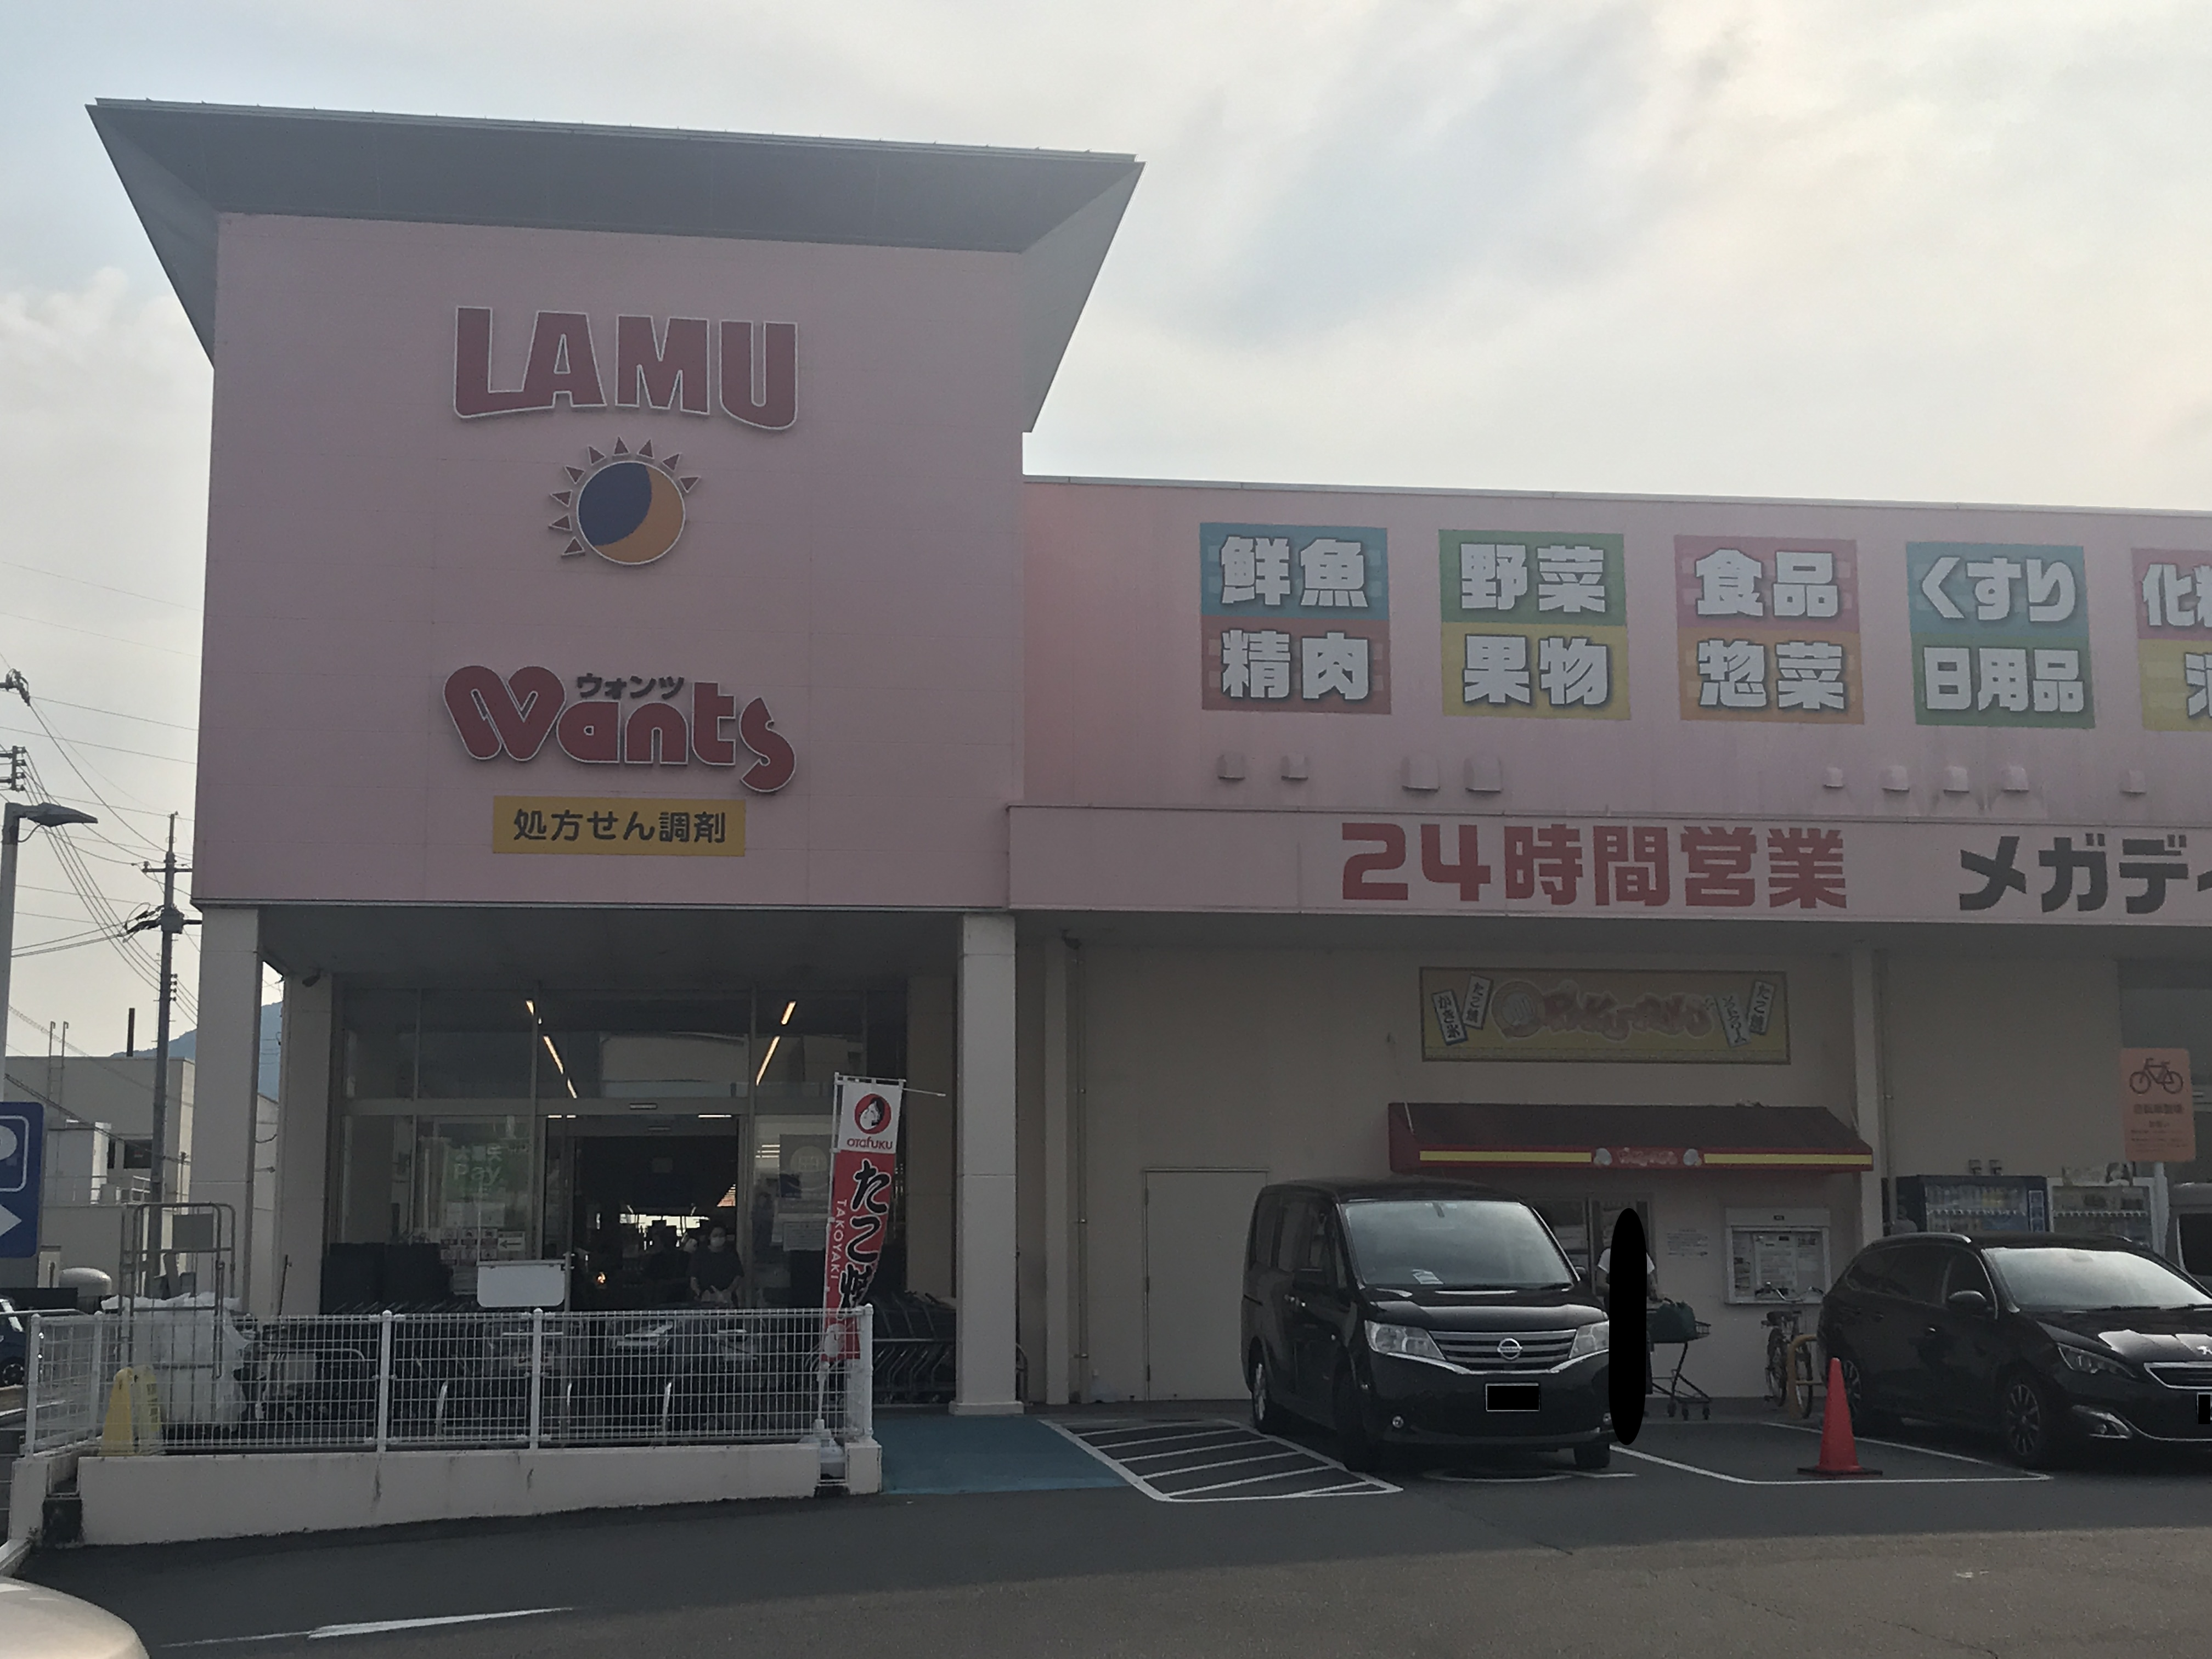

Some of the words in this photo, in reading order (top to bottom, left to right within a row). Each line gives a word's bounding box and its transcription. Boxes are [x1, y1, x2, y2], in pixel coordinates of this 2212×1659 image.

[454, 305, 798, 430] LAMU
[1220, 536, 1368, 608] 鮮魚
[1460, 543, 1606, 613] 野菜
[1695, 549, 1840, 618] 食品
[1921, 557, 2076, 622] くすり
[577, 673, 685, 700] ウォンツ
[1221, 629, 1369, 700] 精肉
[1464, 634, 1609, 706] 果物
[1697, 640, 1846, 709] 惣菜
[1924, 647, 2084, 712] 日用品
[443, 665, 797, 793] Wants
[514, 809, 726, 844] 処方せん調剤
[1342, 822, 1847, 909] 24時間営業
[1438, 996, 1460, 1039] かき氷
[830, 1199, 847, 1280] TAKOYAKI
